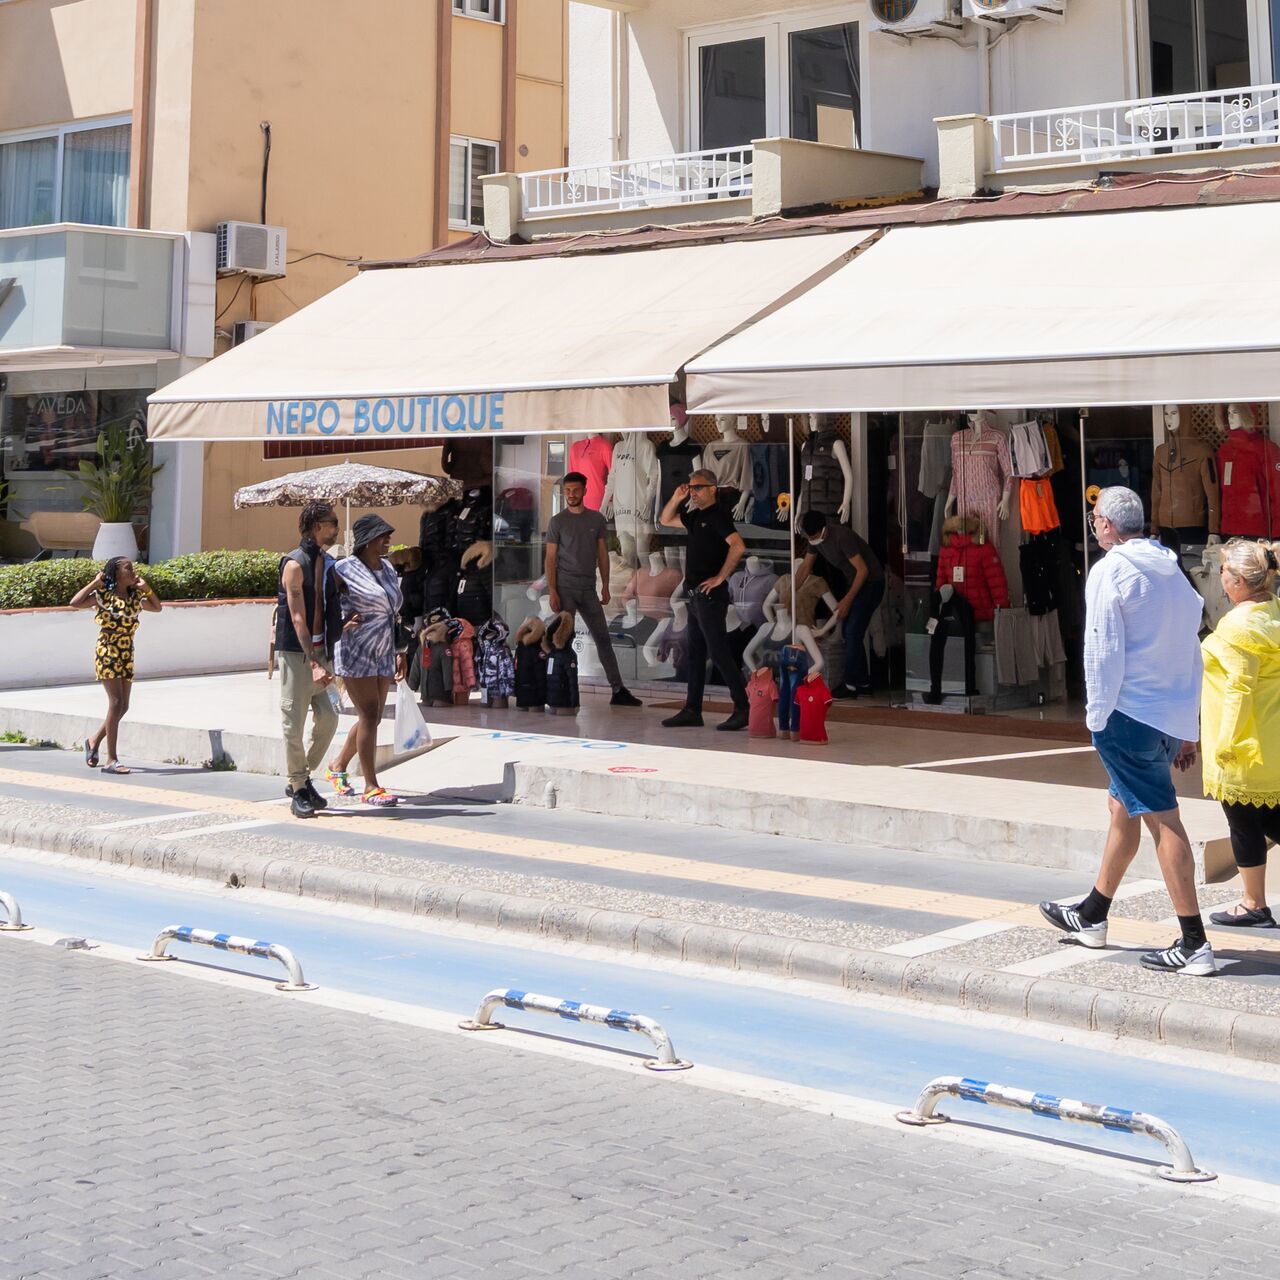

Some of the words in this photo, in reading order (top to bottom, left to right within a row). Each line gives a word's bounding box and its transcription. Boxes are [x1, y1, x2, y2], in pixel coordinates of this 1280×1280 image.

[37, 397, 87, 414] AVEDA
[266, 400, 341, 435] NEPO
[354, 393, 504, 434] BOUTIQUE
[471, 731, 628, 750] NEPO
